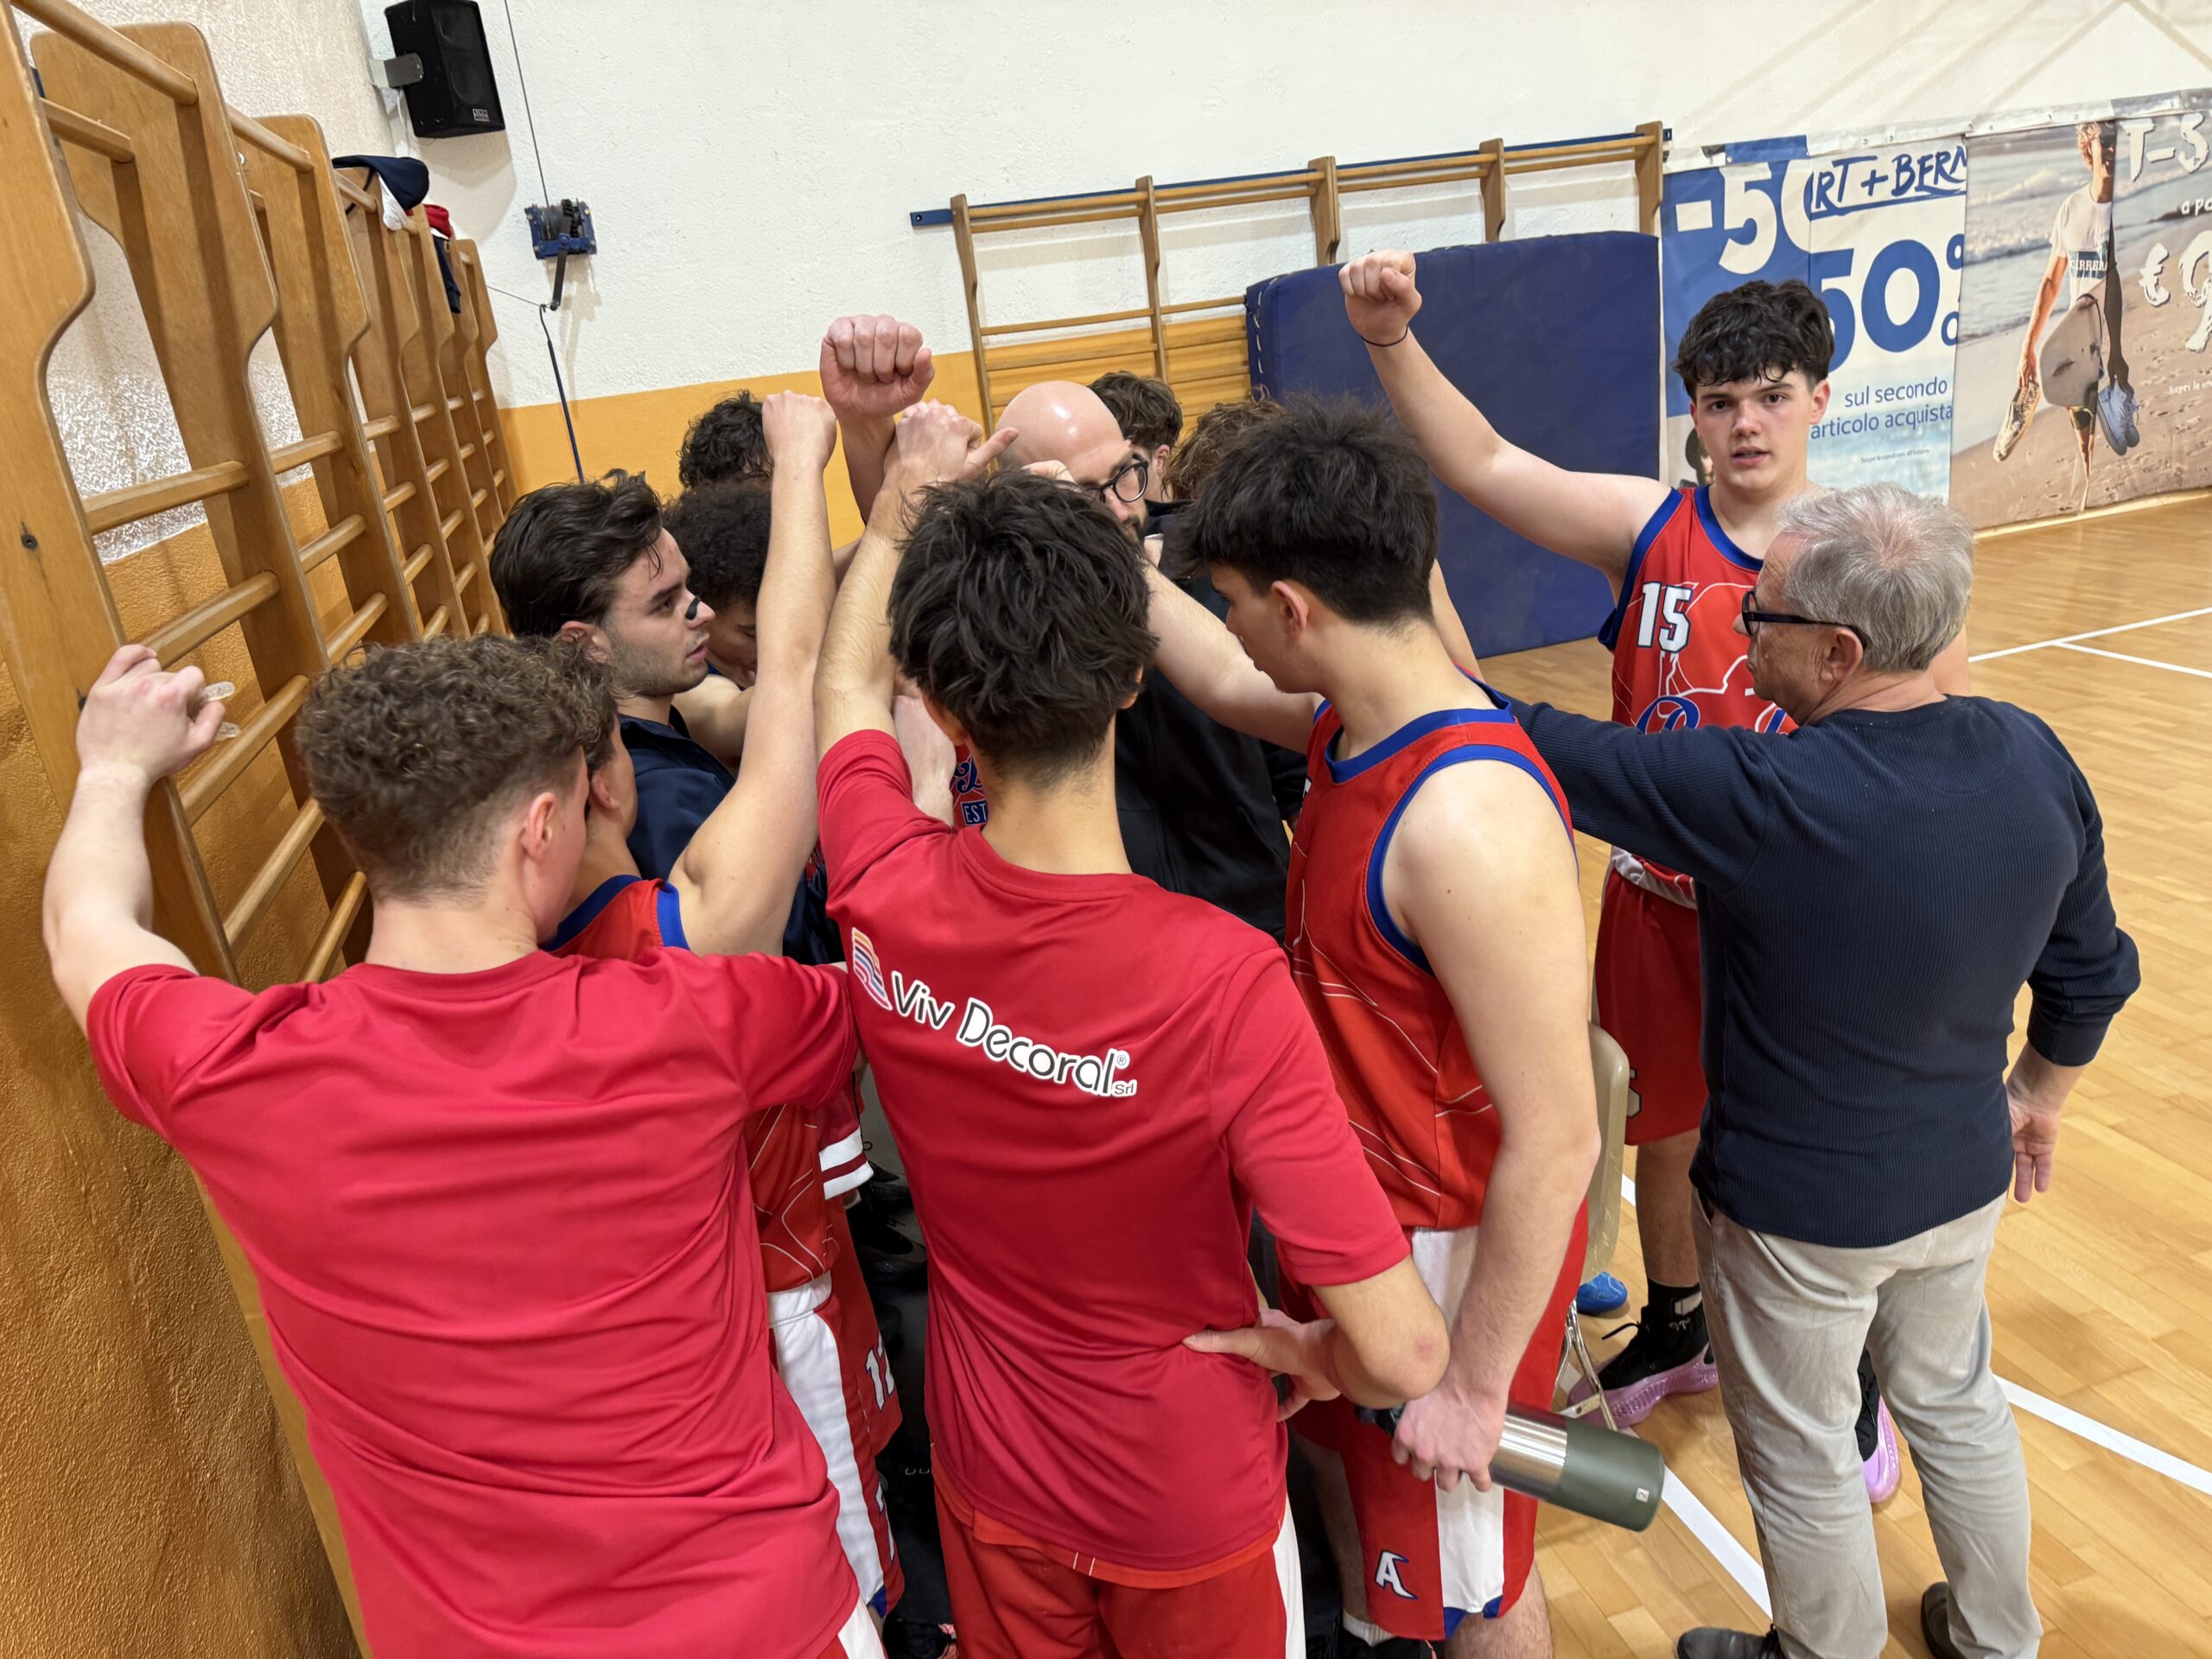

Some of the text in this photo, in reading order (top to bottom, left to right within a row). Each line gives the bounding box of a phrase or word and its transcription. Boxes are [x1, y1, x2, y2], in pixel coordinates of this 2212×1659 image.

[1845, 376, 1948, 408] sul secondo
[1810, 404, 1953, 440] articolo acquista
[1637, 581, 1693, 653] 15
[963, 803, 988, 823] EST
[893, 973, 953, 1028] Viv
[1114, 1083, 1135, 1095] Srl
